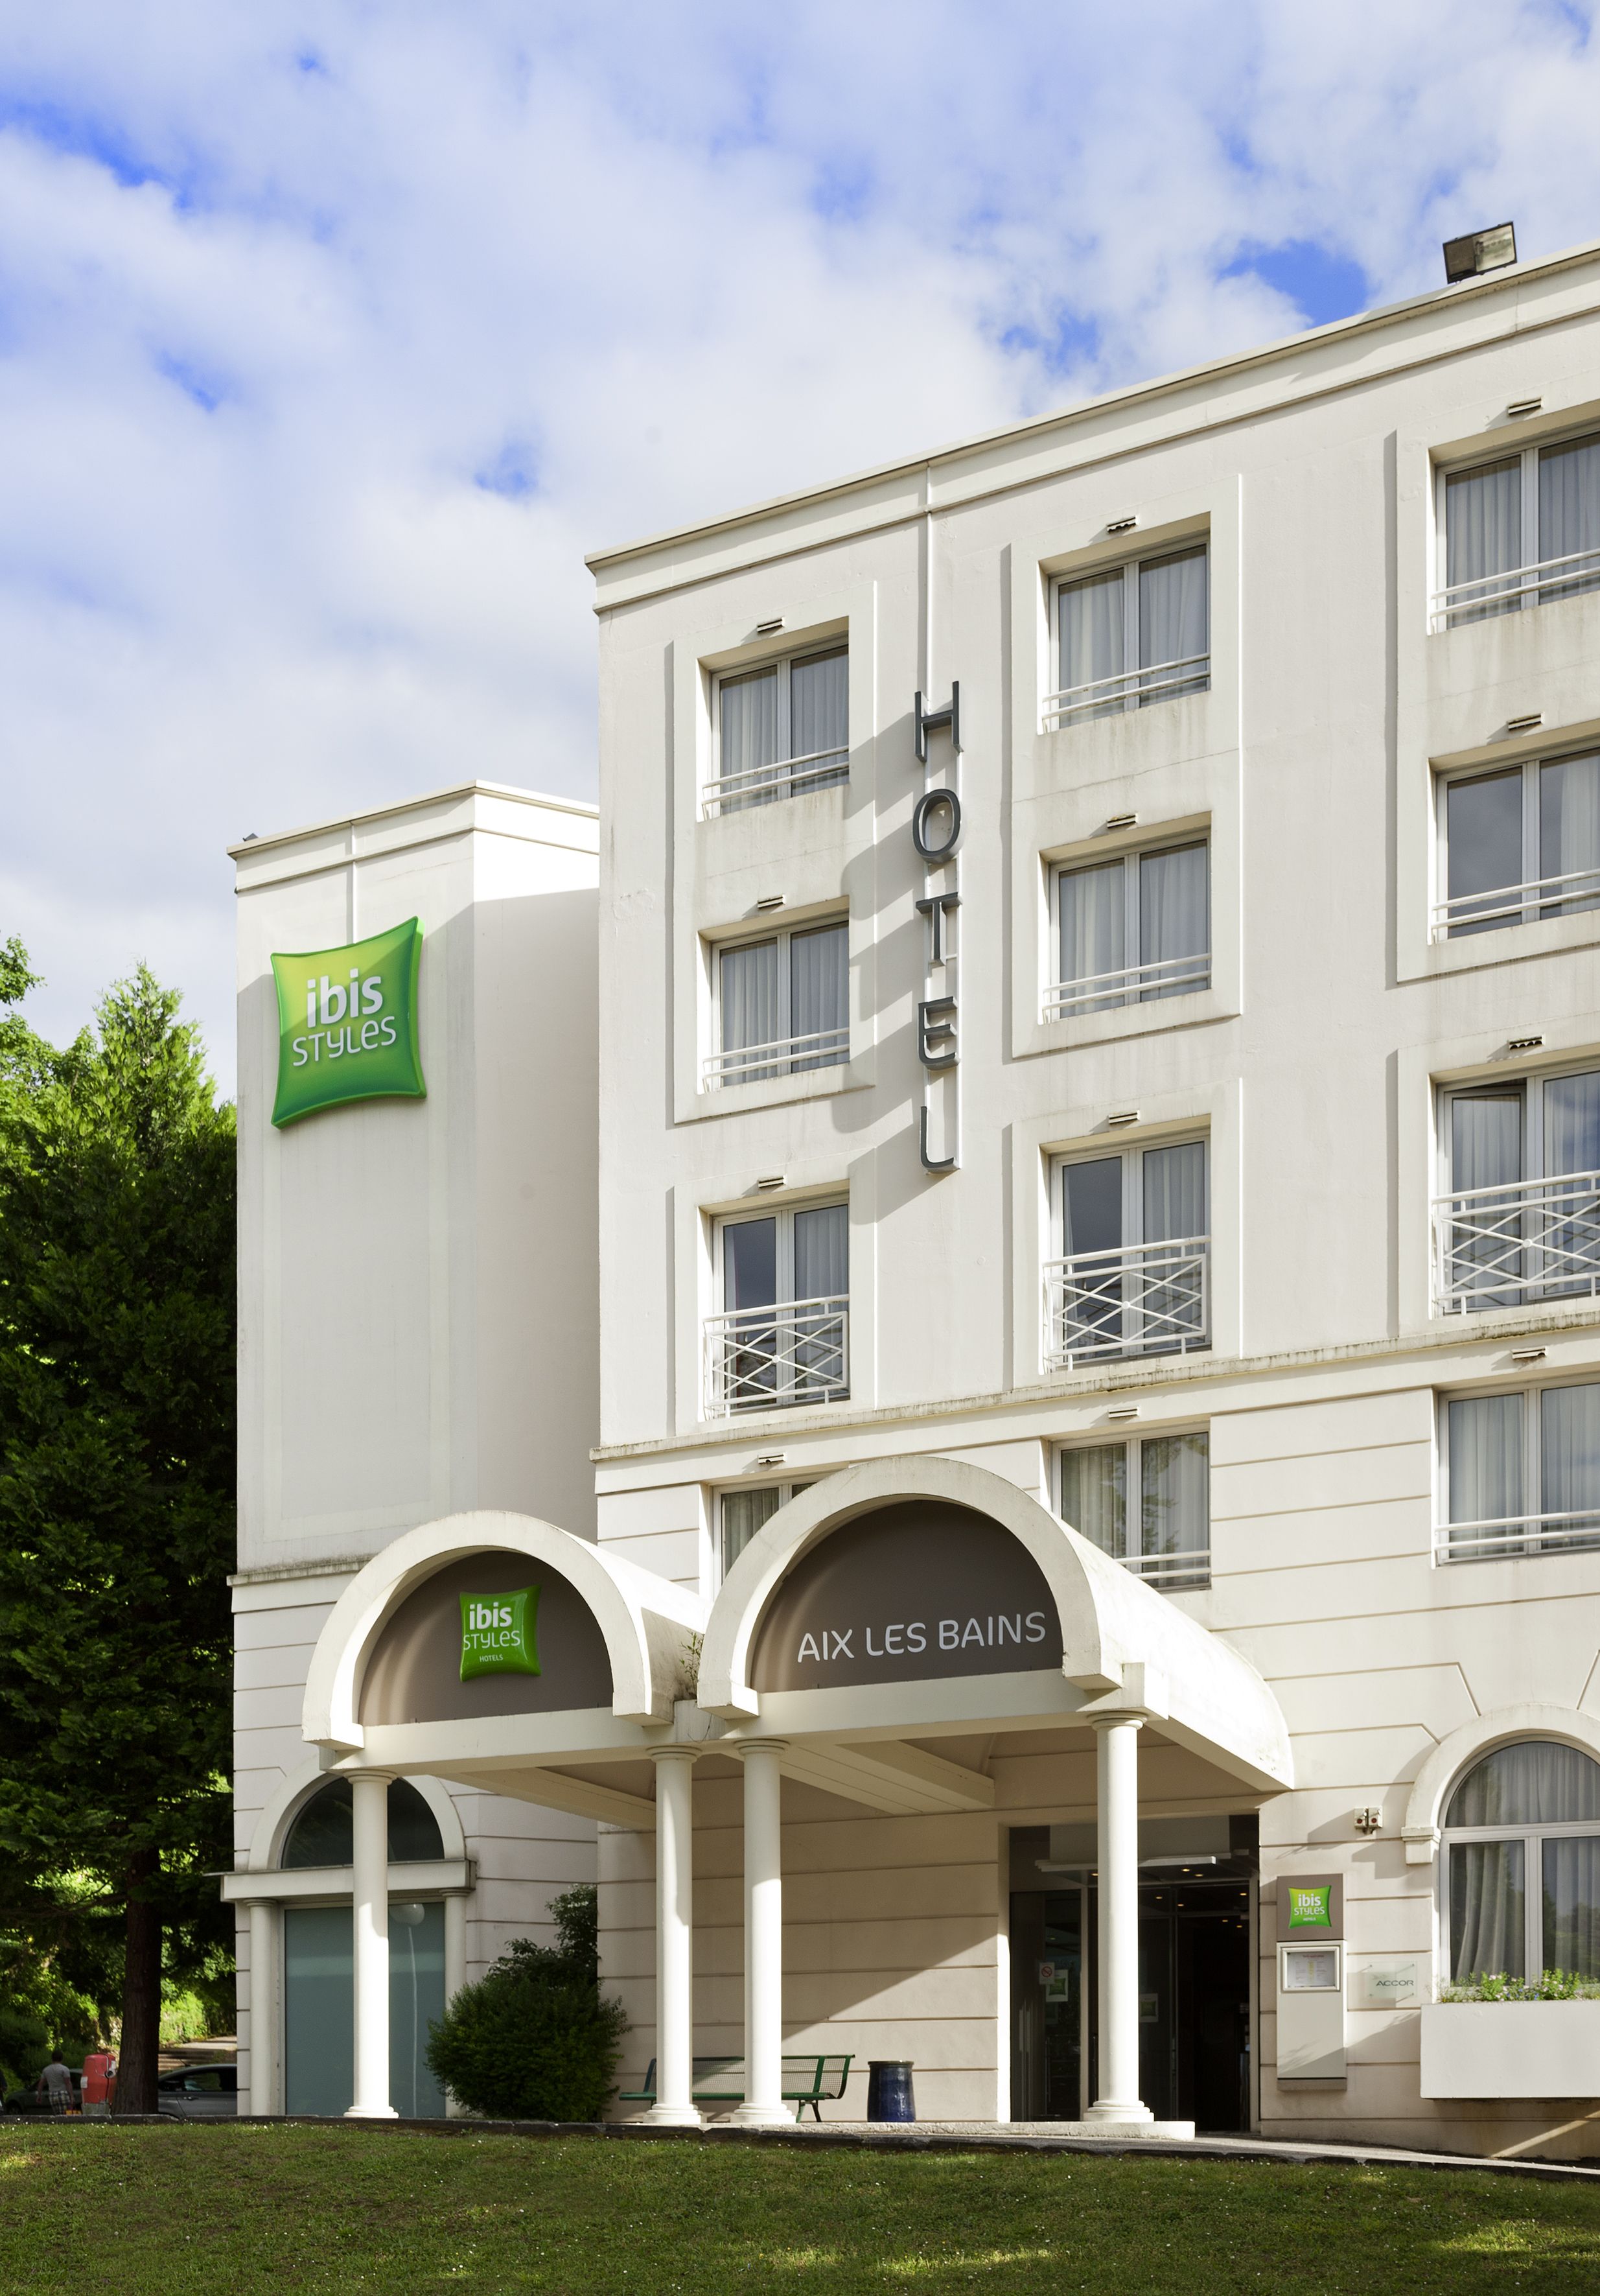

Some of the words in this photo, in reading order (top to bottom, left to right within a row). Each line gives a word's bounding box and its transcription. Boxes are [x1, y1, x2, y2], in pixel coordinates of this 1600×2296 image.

[912, 681, 964, 1171] HOTEL
[307, 968, 383, 1028] ibis
[469, 1602, 512, 1630] ibis
[797, 1628, 855, 1663] AIX
[866, 1622, 927, 1656] LES
[938, 1611, 1046, 1650] BAINS
[480, 1654, 504, 1662] HOTELS
[1298, 1893, 1321, 1907] ibis
